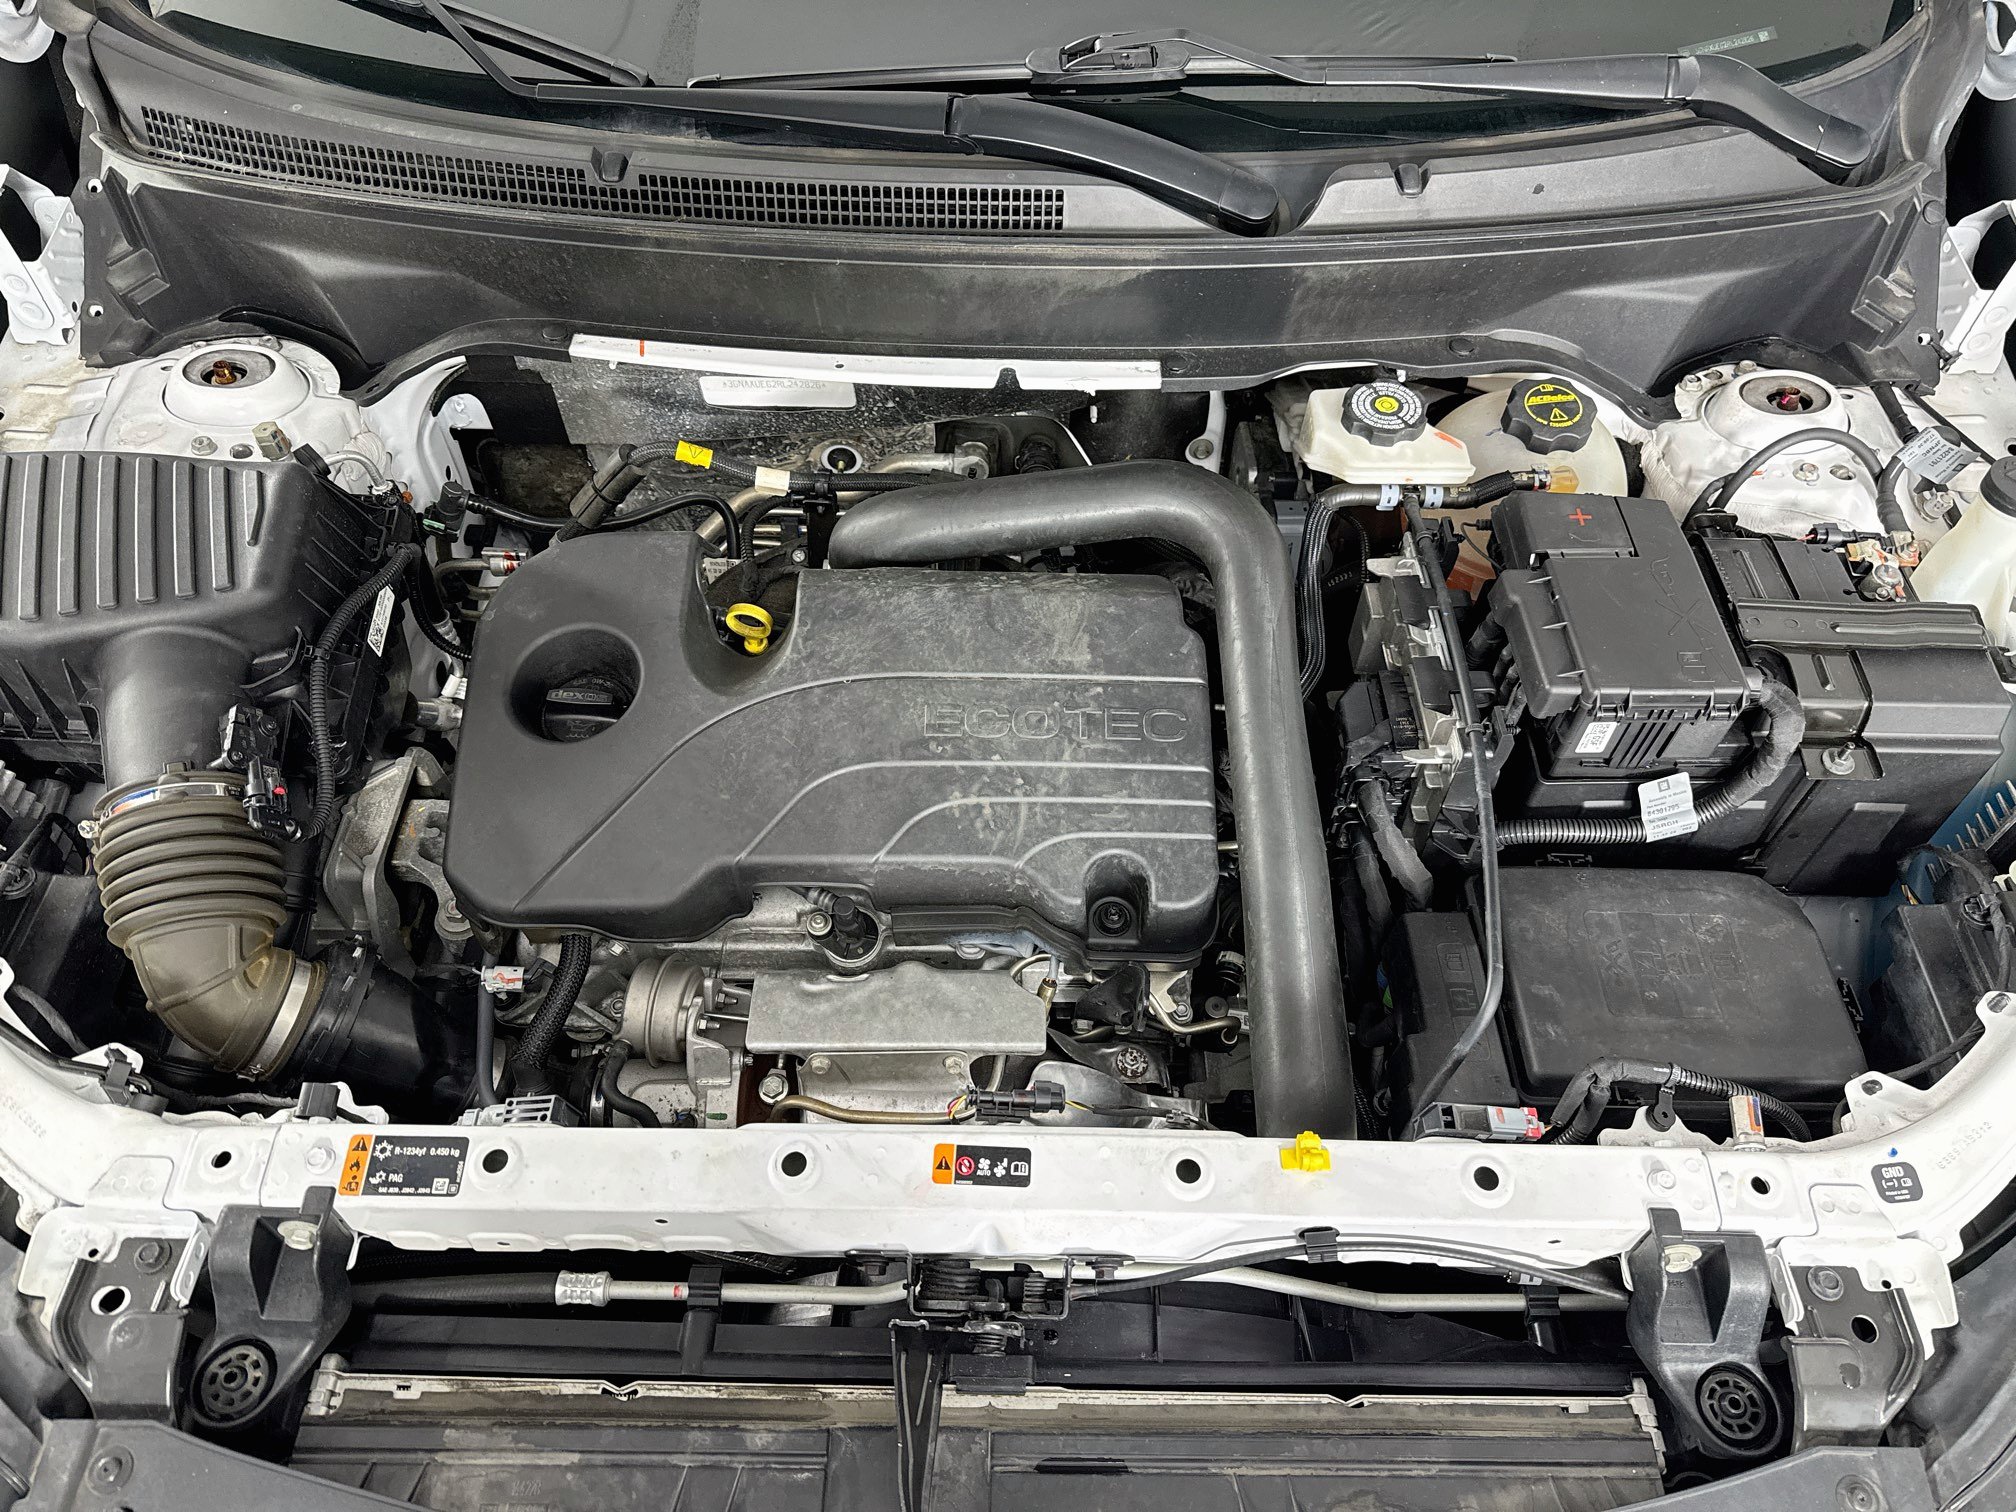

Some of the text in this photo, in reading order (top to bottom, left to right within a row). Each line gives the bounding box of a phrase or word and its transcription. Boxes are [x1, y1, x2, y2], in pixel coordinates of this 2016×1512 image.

[1528, 394, 1576, 404] ACDelco
[551, 689, 608, 700] dexos
[924, 704, 1187, 741] ECOTEC
[394, 1147, 461, 1157] R-1234yf 0.450 kg
[976, 1169, 991, 1177] AUTO
[1881, 1165, 1904, 1178] GND
[388, 1173, 403, 1183] PAG
